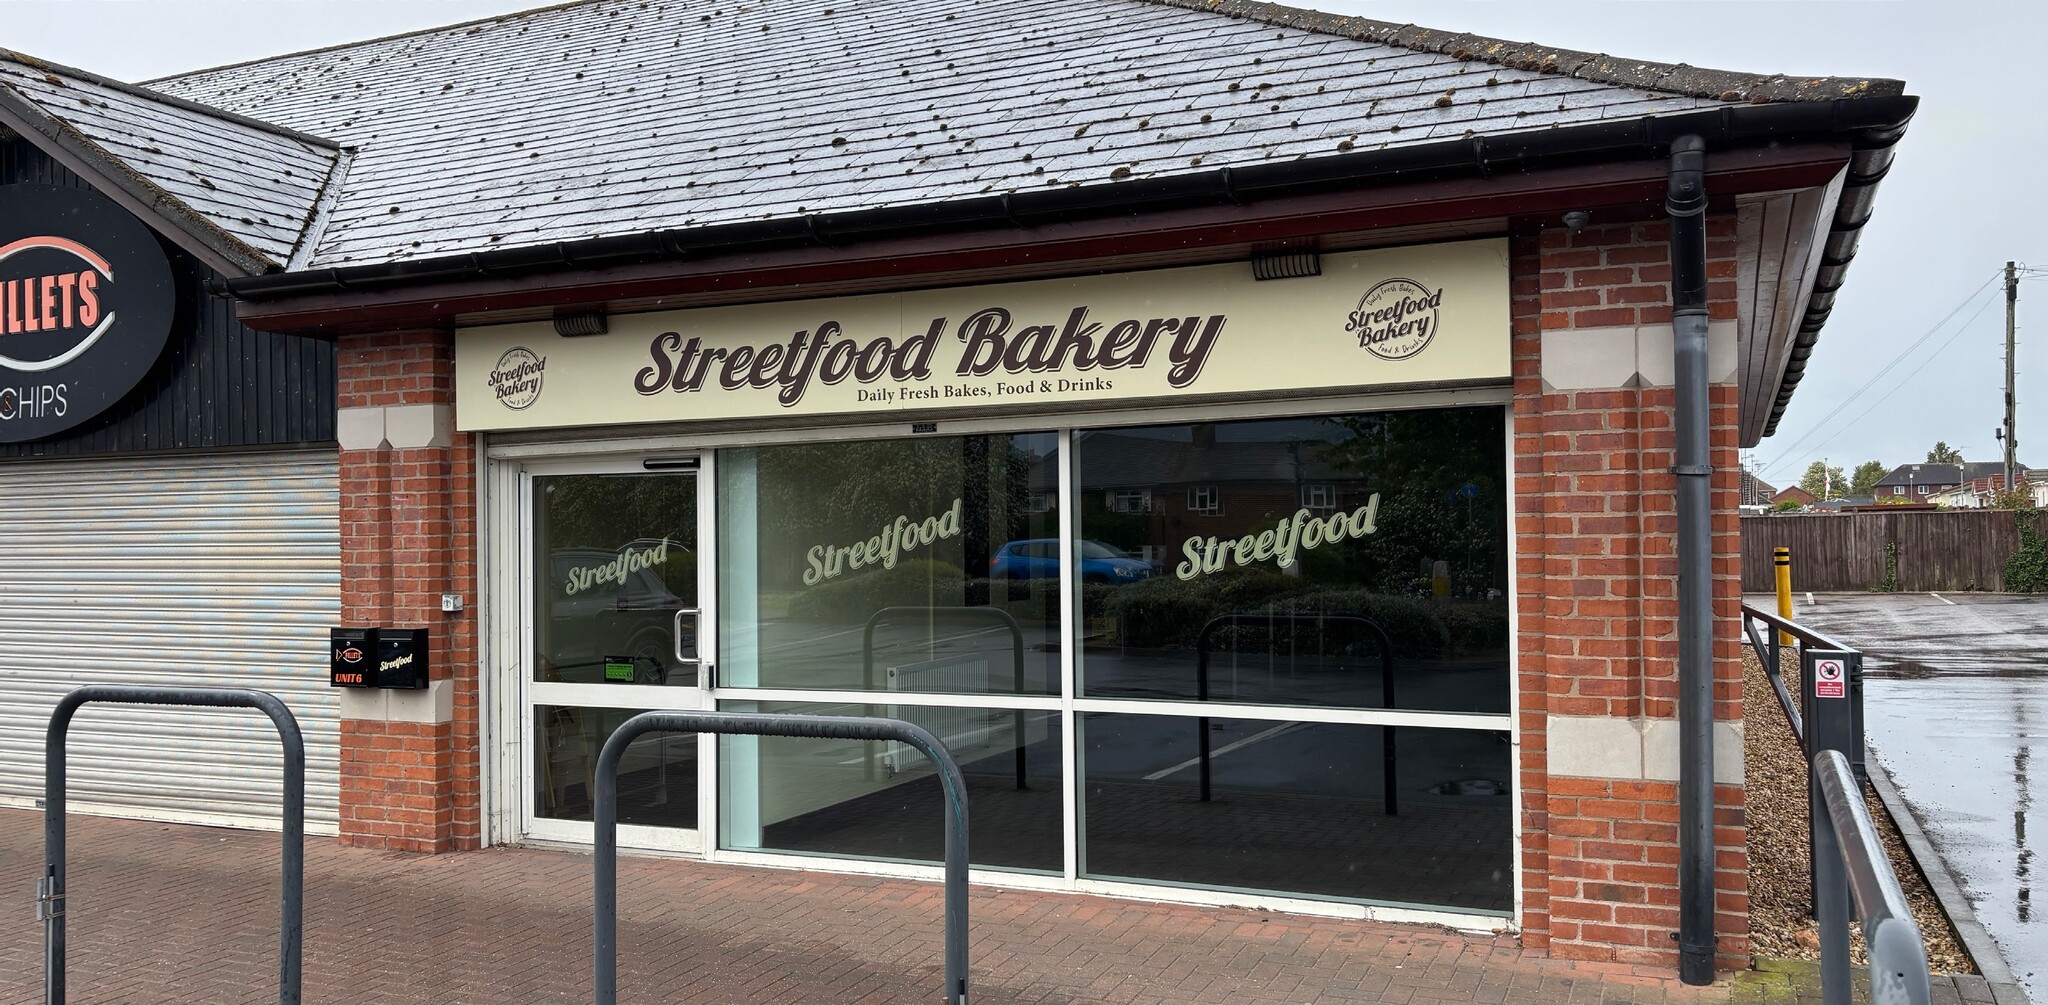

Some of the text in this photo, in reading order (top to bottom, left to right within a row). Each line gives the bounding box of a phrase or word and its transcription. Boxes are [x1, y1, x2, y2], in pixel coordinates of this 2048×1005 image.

[1345, 288, 1443, 332] Streetfood
[1366, 283, 1415, 306] Daily Fresh Bakes
[1357, 316, 1430, 348] Bakery
[1378, 343, 1392, 354] Food
[1402, 338, 1423, 353] Drinks
[488, 356, 546, 387] Streetfood
[634, 306, 1227, 407] Streetfood Bakery
[0, 384, 67, 420] CHIPS
[495, 377, 538, 399] Bakery
[857, 377, 1113, 404] Daily Fresh Bakes, Food & Drinks
[803, 497, 962, 586] Streetfood
[1176, 492, 1380, 581] Streetfood
[565, 536, 669, 596] Streetfood
[380, 653, 413, 671] Streetfood
[335, 673, 362, 683] UNIT 6
